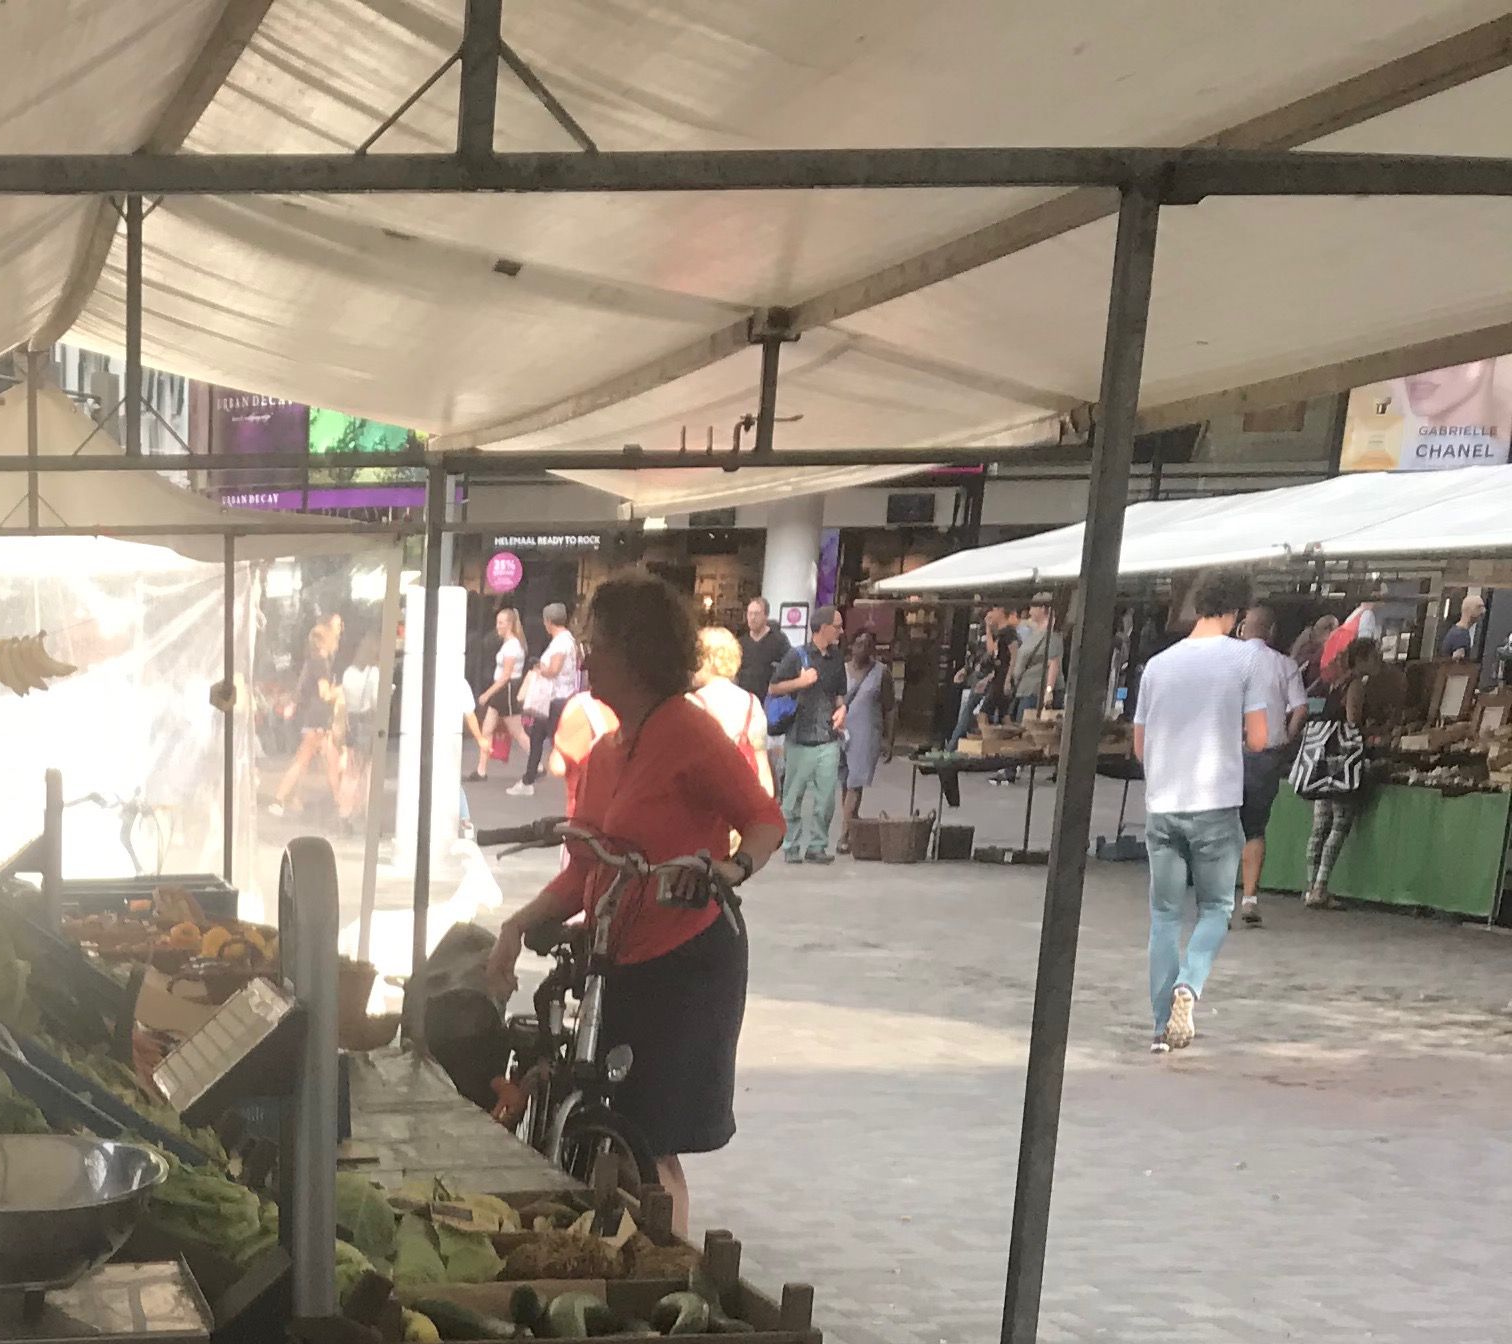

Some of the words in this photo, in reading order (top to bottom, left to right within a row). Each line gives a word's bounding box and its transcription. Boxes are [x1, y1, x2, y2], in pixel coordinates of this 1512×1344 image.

[217, 396, 249, 412] URBAN
[1418, 425, 1498, 437] GABRIELLE
[1416, 443, 1495, 459] CHANEL
[222, 494, 247, 506] URBAN
[249, 493, 279, 504] DECAY
[537, 536, 564, 546] READY
[565, 535, 576, 545] TO
[577, 535, 601, 545] ROCK
